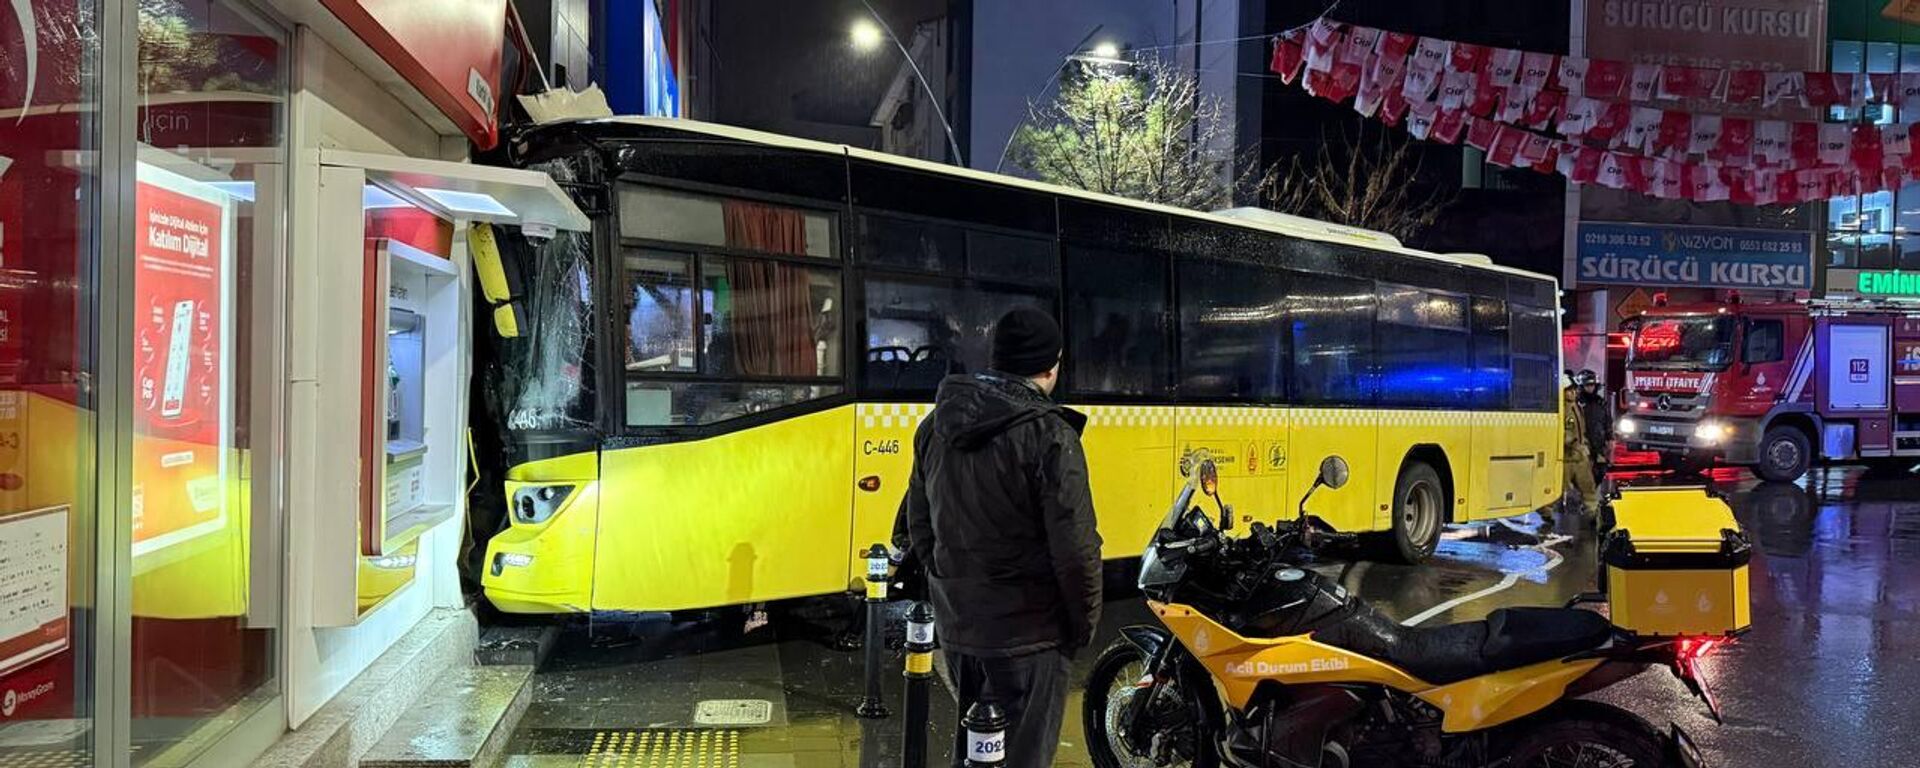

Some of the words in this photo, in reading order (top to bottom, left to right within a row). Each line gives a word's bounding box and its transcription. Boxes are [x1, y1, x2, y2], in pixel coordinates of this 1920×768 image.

[1722, 5, 1810, 38] KURSU
[1425, 50, 1442, 60] CHP
[1527, 68, 1547, 78] CHP
[1445, 86, 1464, 96] CHP
[151, 110, 190, 131] için
[149, 224, 182, 252] Katılım
[183, 234, 209, 259] Dijital
[1582, 253, 1699, 284] SÜRÜCÜ
[1710, 262, 1805, 287] KURSU
[1852, 361, 1867, 373] 112
[864, 439, 899, 455] C-446
[1225, 661, 1254, 673] Acil
[1257, 661, 1306, 673] Durum
[1310, 657, 1348, 672] Ekibi
[975, 739, 1004, 754] 202
